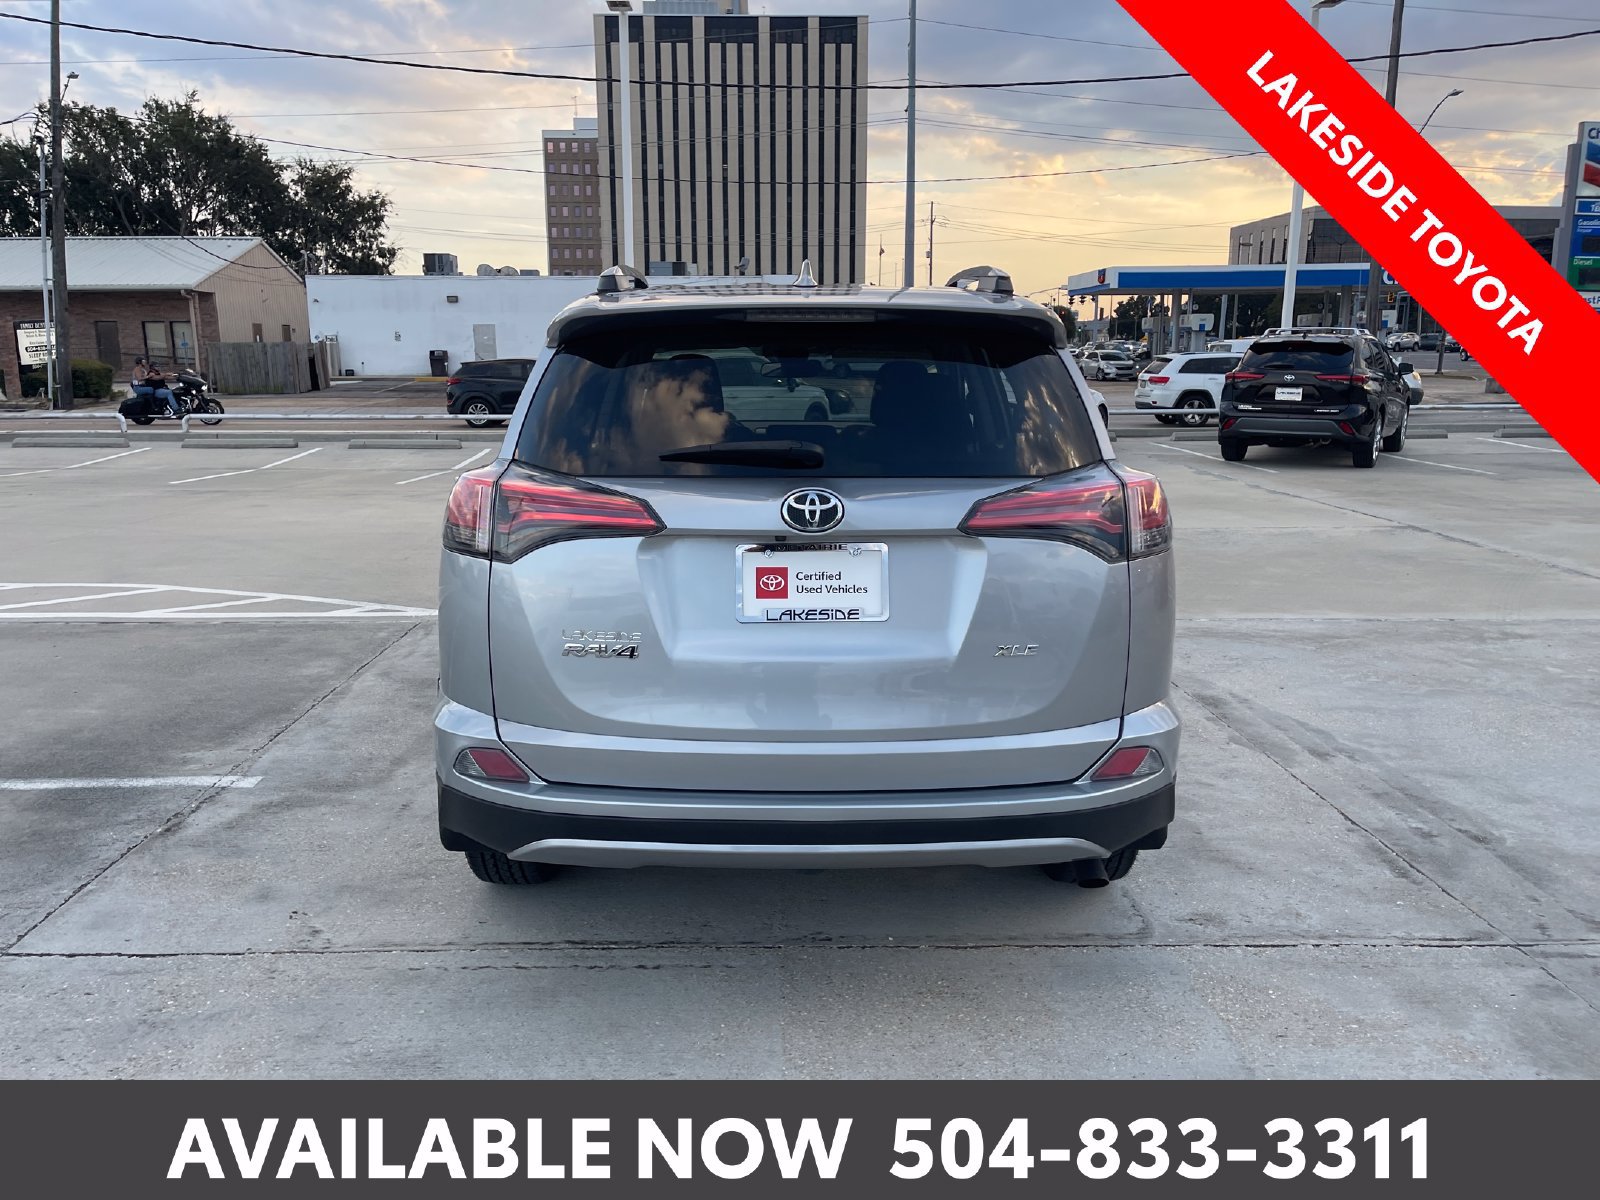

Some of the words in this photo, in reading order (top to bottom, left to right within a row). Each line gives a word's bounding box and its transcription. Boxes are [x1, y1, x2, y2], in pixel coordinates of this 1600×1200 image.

[796, 571, 842, 581] Certified
[796, 585, 822, 594] Used
[825, 585, 868, 594] Vehicles
[562, 643, 639, 659] RAV4
[994, 644, 1039, 656] XLE
